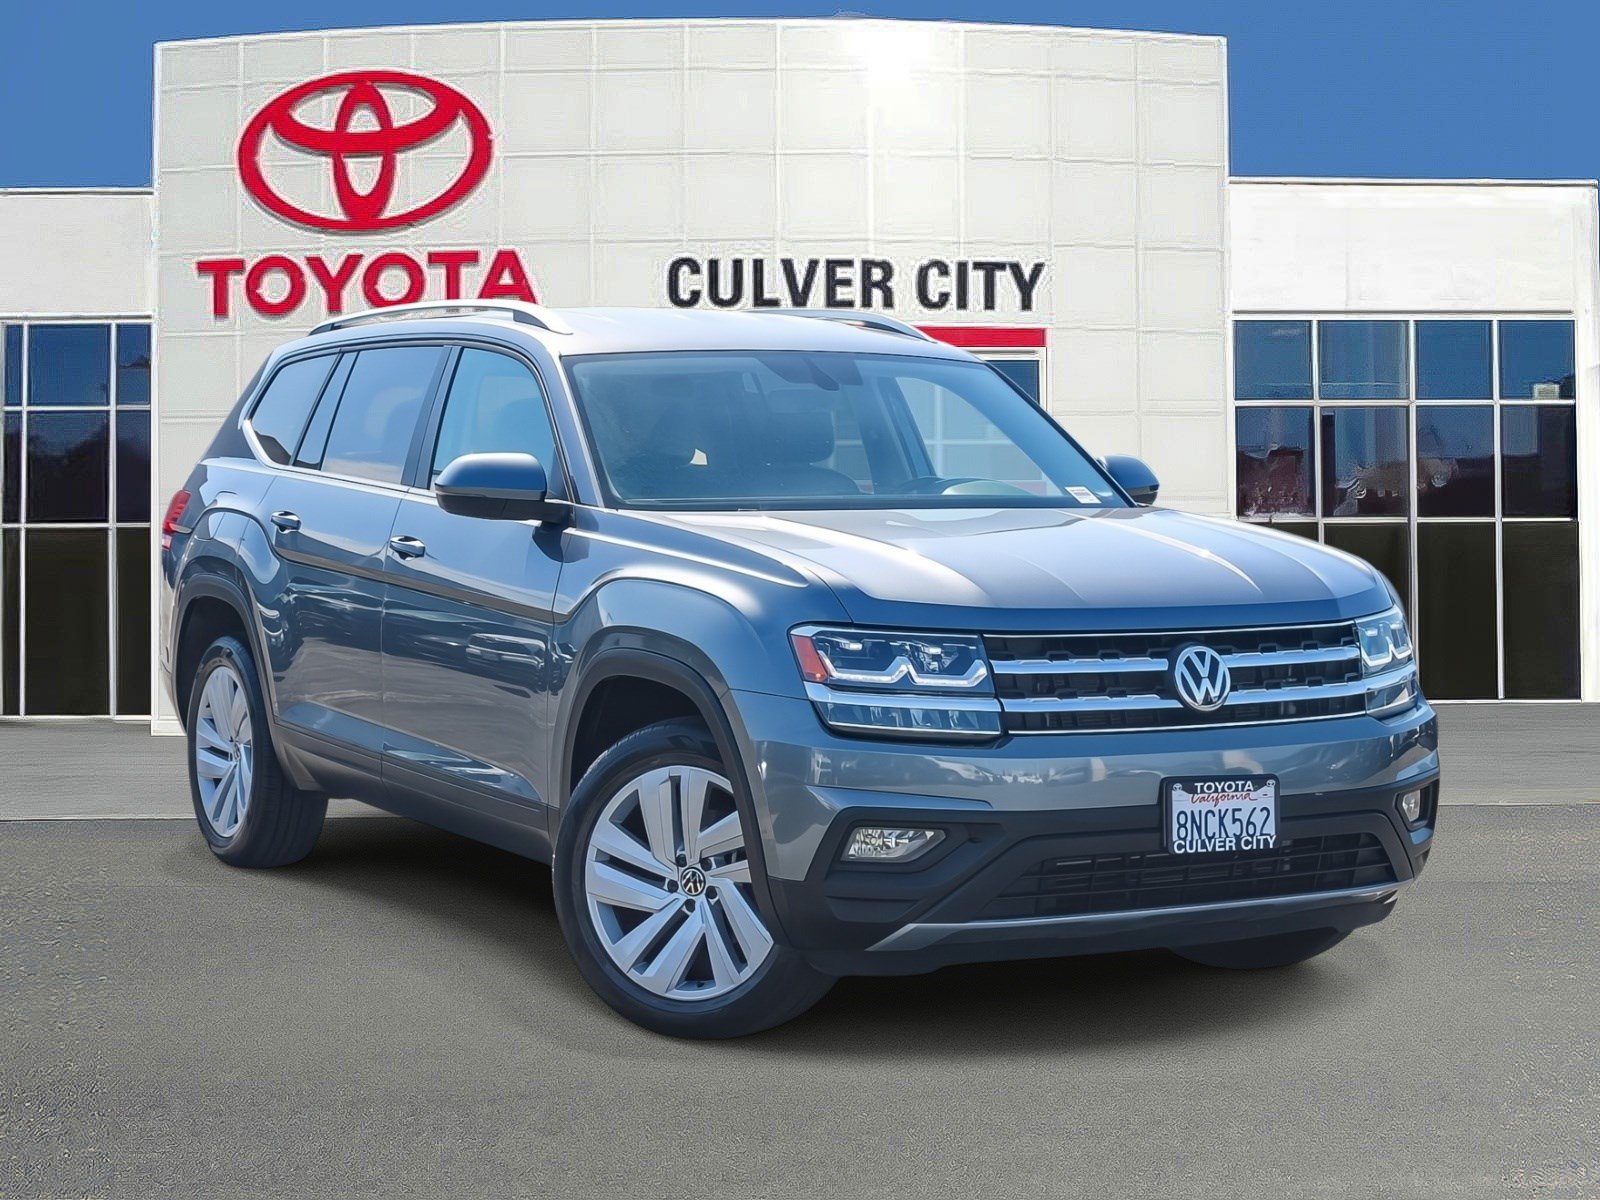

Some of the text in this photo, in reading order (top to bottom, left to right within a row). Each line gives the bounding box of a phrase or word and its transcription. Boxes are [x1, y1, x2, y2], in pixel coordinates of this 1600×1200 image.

[197, 249, 538, 318] TOYOTA
[668, 257, 1046, 311] CULVER CITY
[1191, 792, 1257, 807] California
[1195, 780, 1254, 793] TOYOTA
[1176, 806, 1271, 840] 8NCK562
[1173, 835, 1277, 854] CULVER CITY
